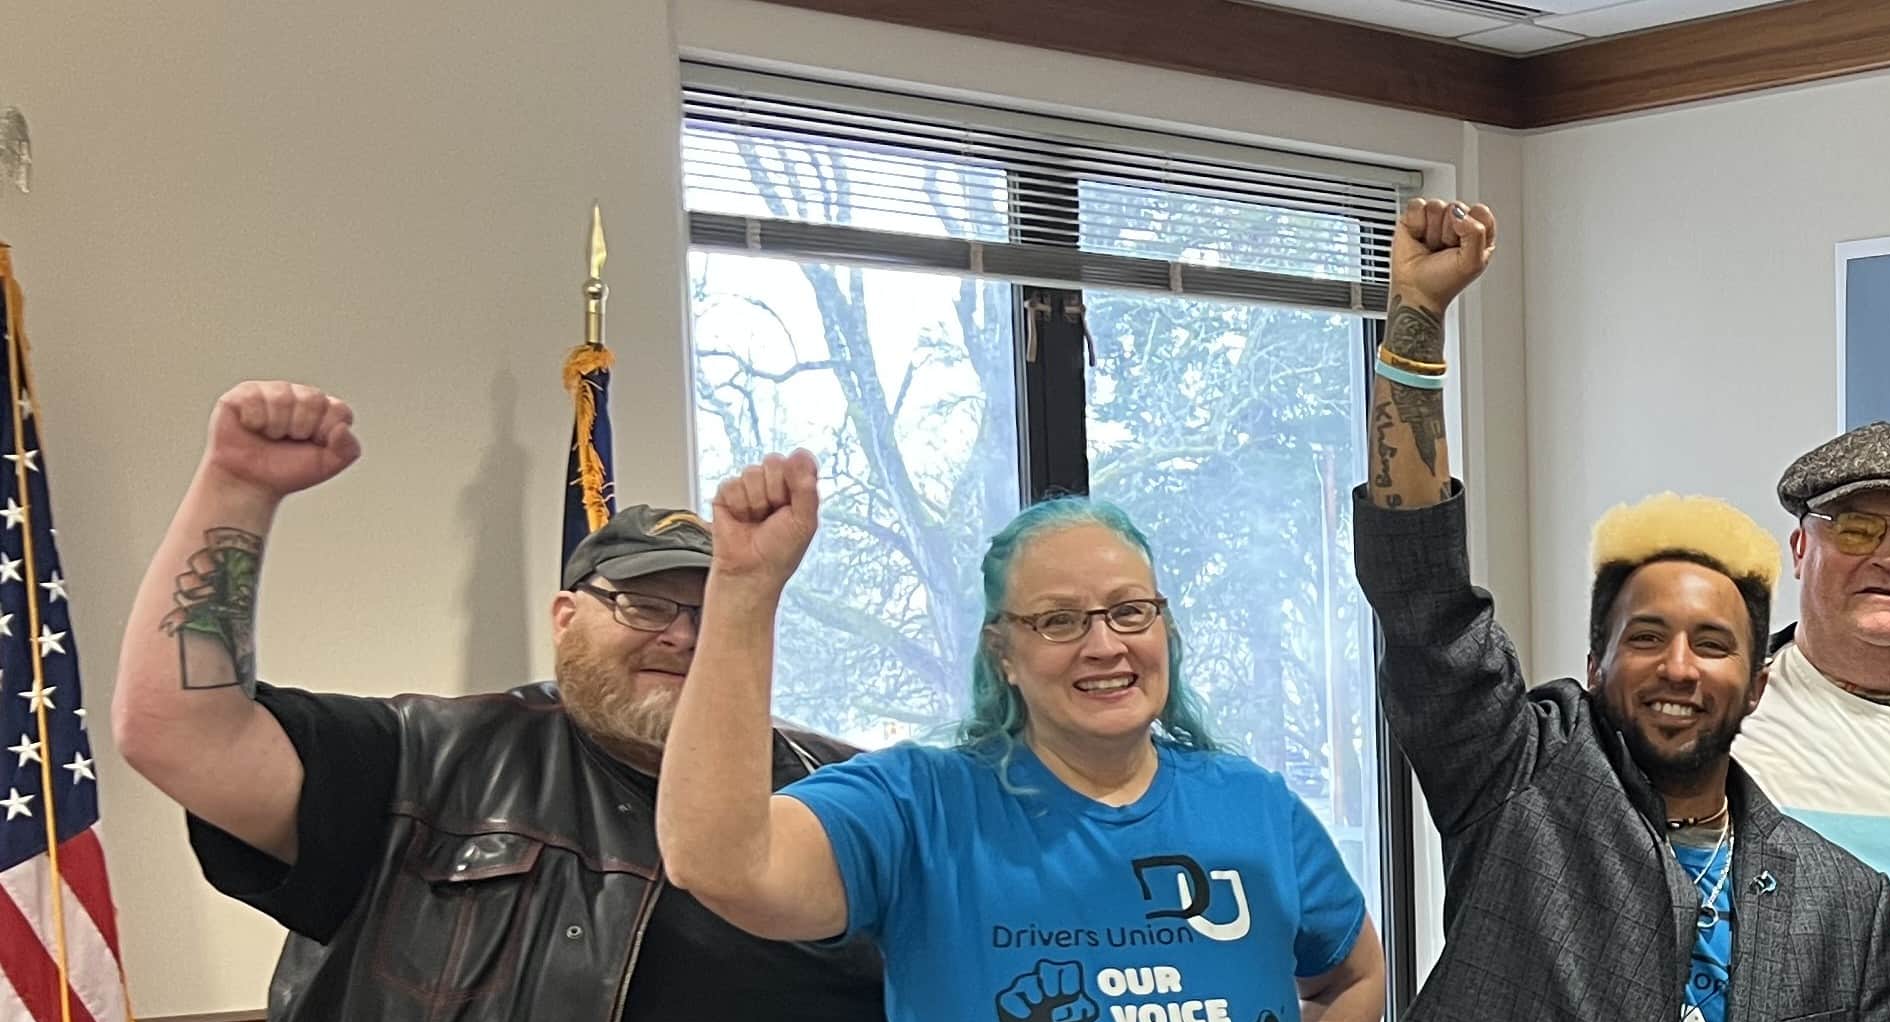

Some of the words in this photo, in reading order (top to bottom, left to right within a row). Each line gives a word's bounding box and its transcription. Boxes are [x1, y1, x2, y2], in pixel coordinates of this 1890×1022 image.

[992, 924, 1098, 948] Drivers
[1106, 925, 1194, 947] Union
[1097, 965, 1182, 997] OUR
